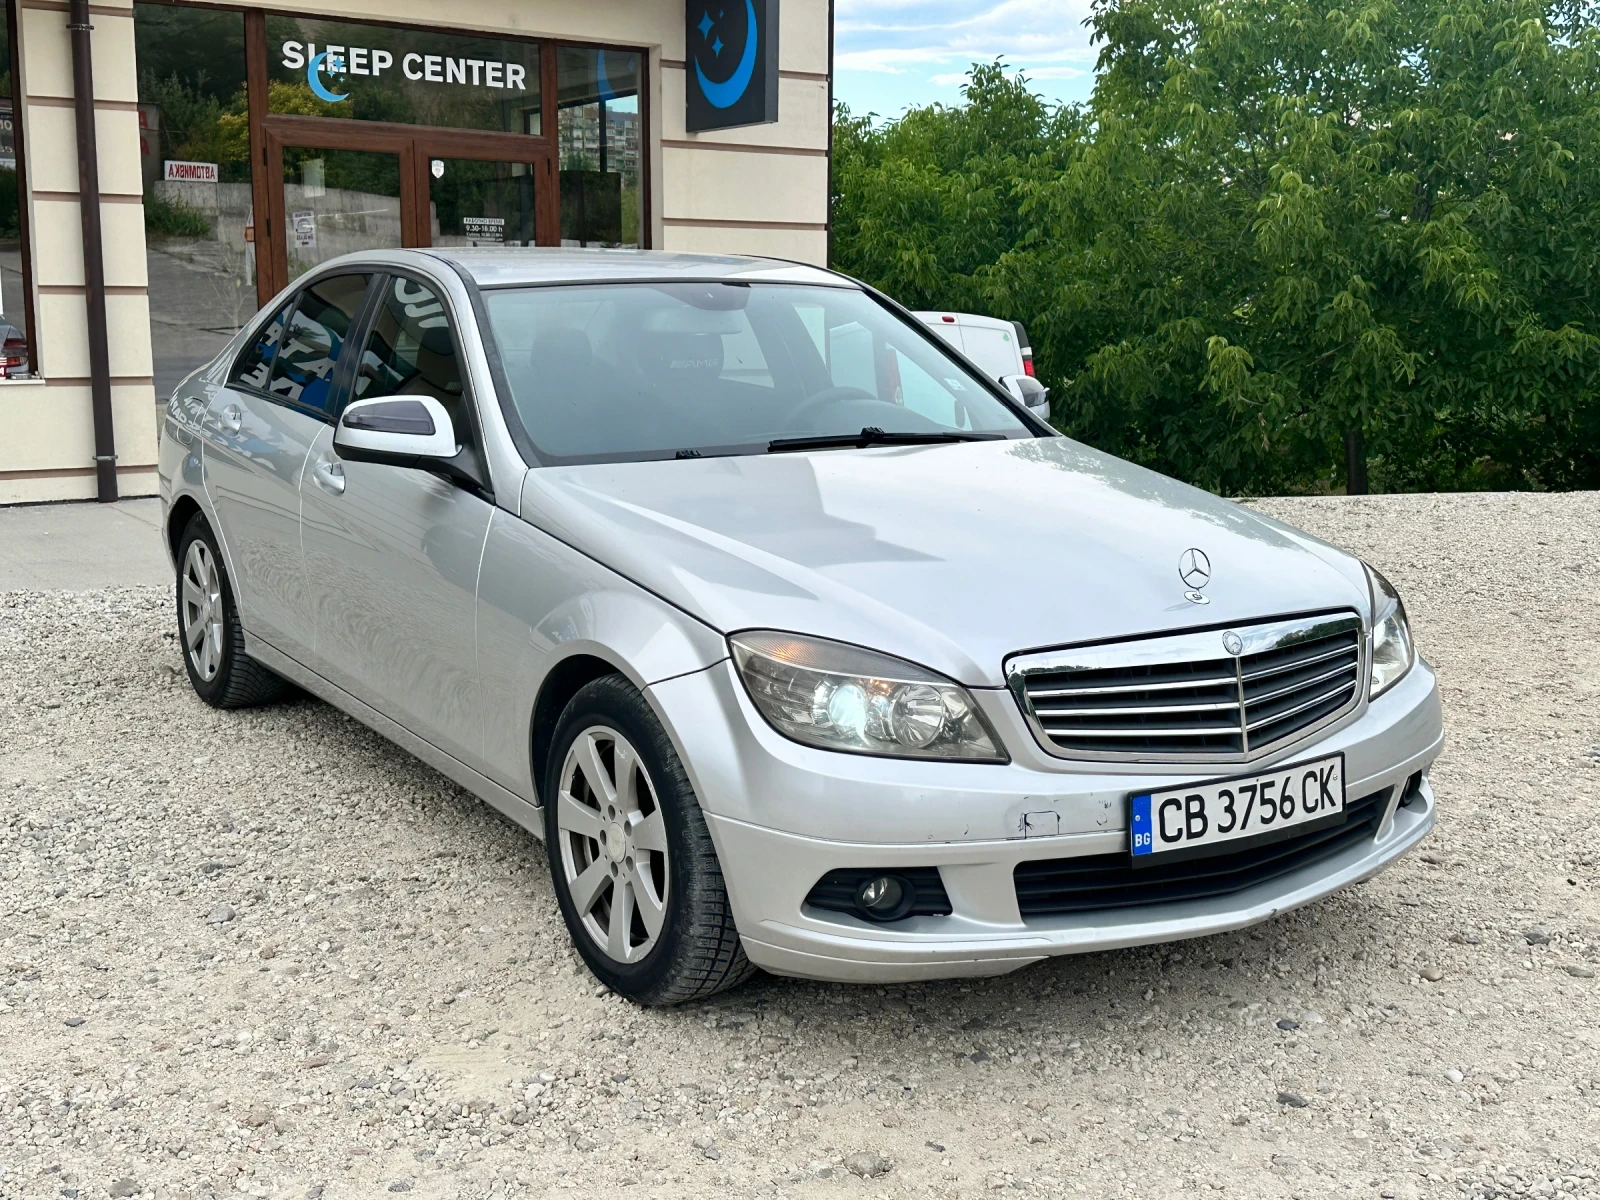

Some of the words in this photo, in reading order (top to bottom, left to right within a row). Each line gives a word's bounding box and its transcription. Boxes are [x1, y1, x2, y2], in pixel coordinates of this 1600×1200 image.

[281, 40, 393, 76] SLEEP
[402, 52, 526, 90] CENTER
[1158, 793, 1209, 843] CB
[1217, 776, 1295, 833] 3756
[1301, 765, 1337, 814] CK
[1134, 832, 1151, 847] BG
